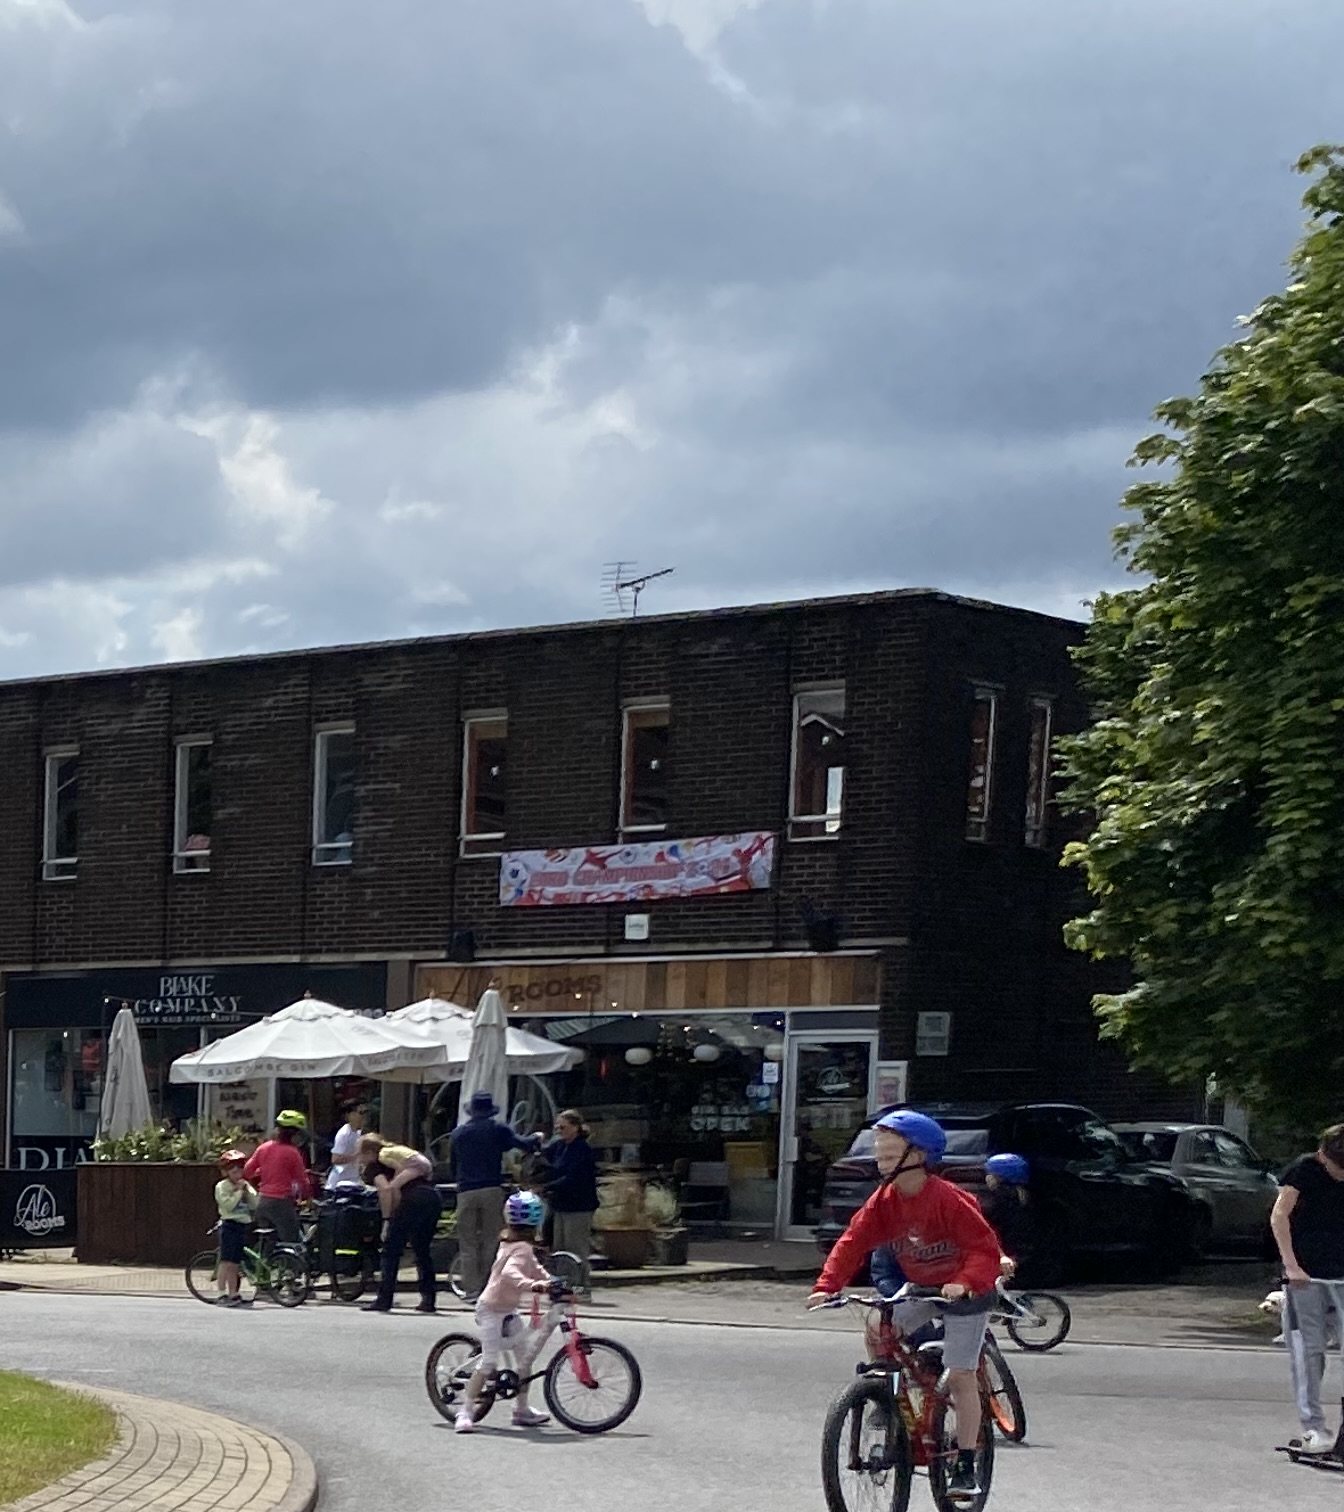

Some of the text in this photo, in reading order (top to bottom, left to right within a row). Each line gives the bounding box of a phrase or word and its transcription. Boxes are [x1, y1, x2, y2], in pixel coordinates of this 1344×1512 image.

[159, 975, 215, 997] BLAKE
[508, 974, 602, 1004] ROOMS
[134, 996, 241, 1014] COMPANY
[207, 1063, 316, 1078] SALCOMBE GIN
